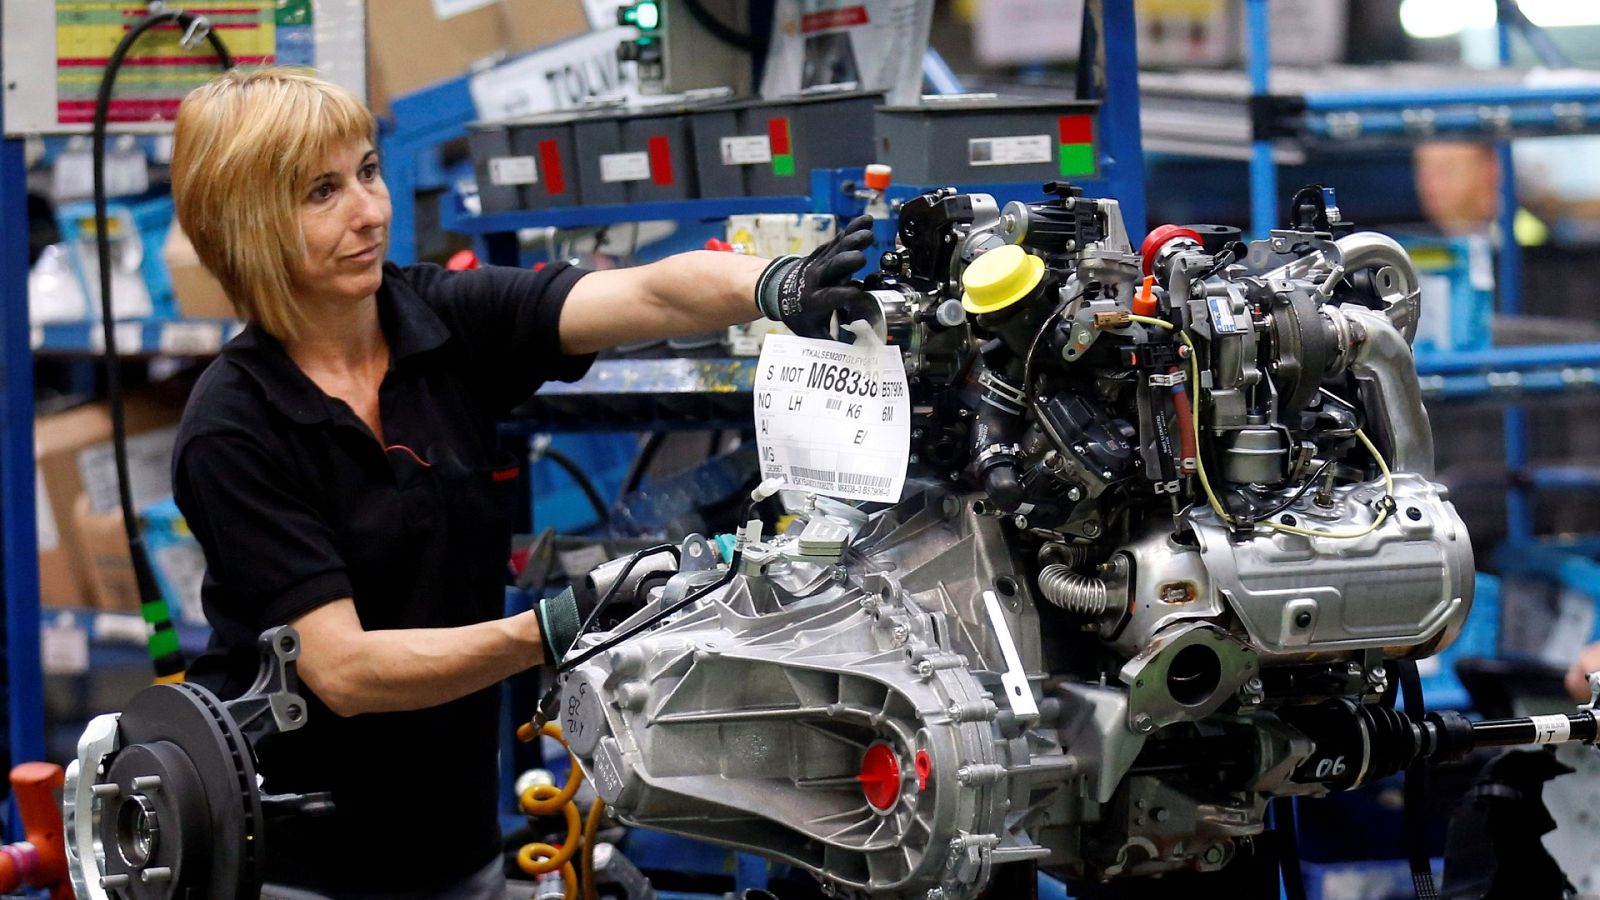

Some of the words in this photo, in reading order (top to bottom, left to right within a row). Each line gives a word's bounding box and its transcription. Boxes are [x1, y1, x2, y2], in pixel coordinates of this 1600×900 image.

[766, 364, 775, 381] S
[780, 366, 804, 383] MOT
[758, 393, 772, 409] NO
[788, 395, 803, 411] LH
[846, 403, 863, 419] K6
[881, 406, 894, 421] 6M
